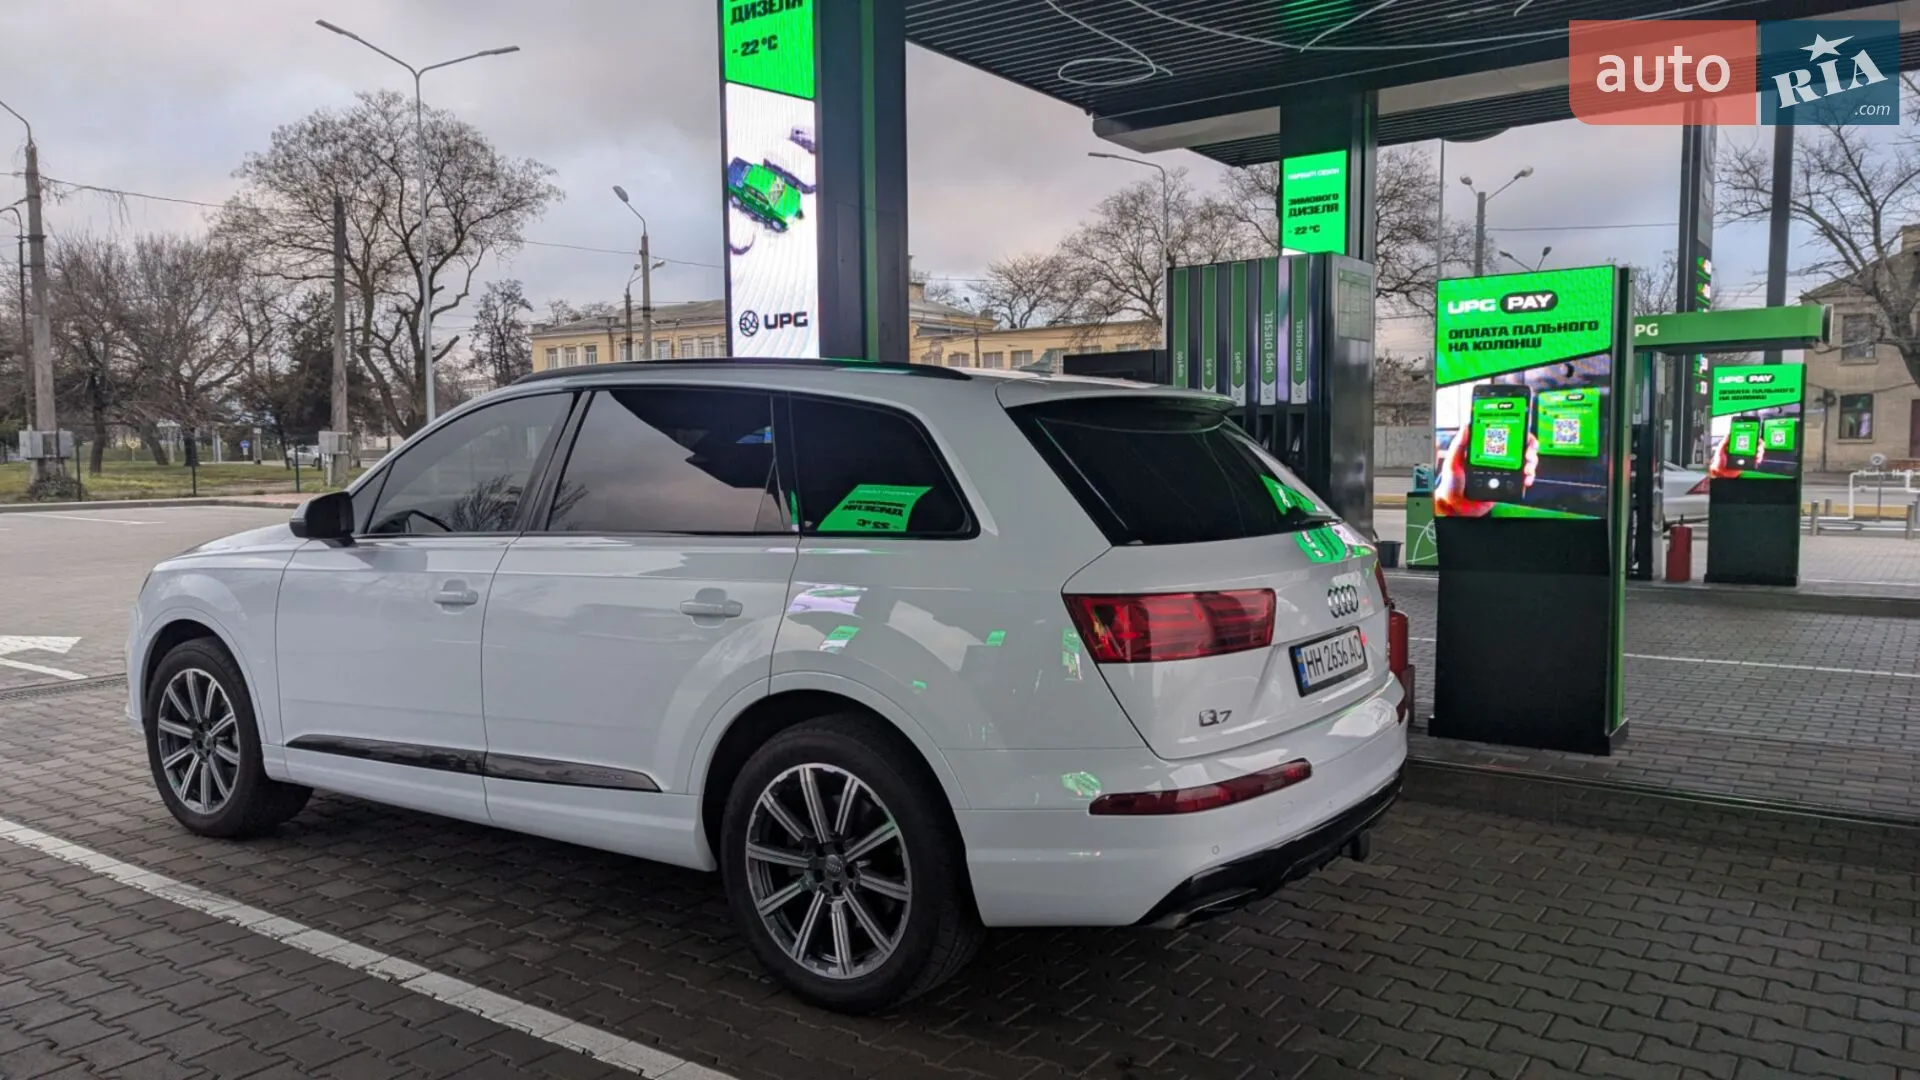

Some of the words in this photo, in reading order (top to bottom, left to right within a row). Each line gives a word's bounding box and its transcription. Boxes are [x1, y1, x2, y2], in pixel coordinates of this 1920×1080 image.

[1288, 203, 1339, 218] ДИЗЕЛЯ
[1447, 298, 1497, 315] UPG
[1507, 294, 1553, 311] PAY
[764, 311, 808, 330] UPG
[1264, 310, 1273, 350] DIESEL
[1448, 326, 1509, 340] ОПЛАТА
[1511, 320, 1600, 336] ПАЛЬНОГО
[1634, 323, 1659, 337] PG
[1296, 318, 1304, 347] DIESEL
[1448, 341, 1470, 352] НА
[1266, 352, 1275, 373] upg
[1749, 374, 1773, 383] PAY
[1304, 648, 1325, 678] HH
[1323, 639, 1349, 672] 2656
[1347, 635, 1362, 663] AC
[1199, 709, 1232, 727] Q7
